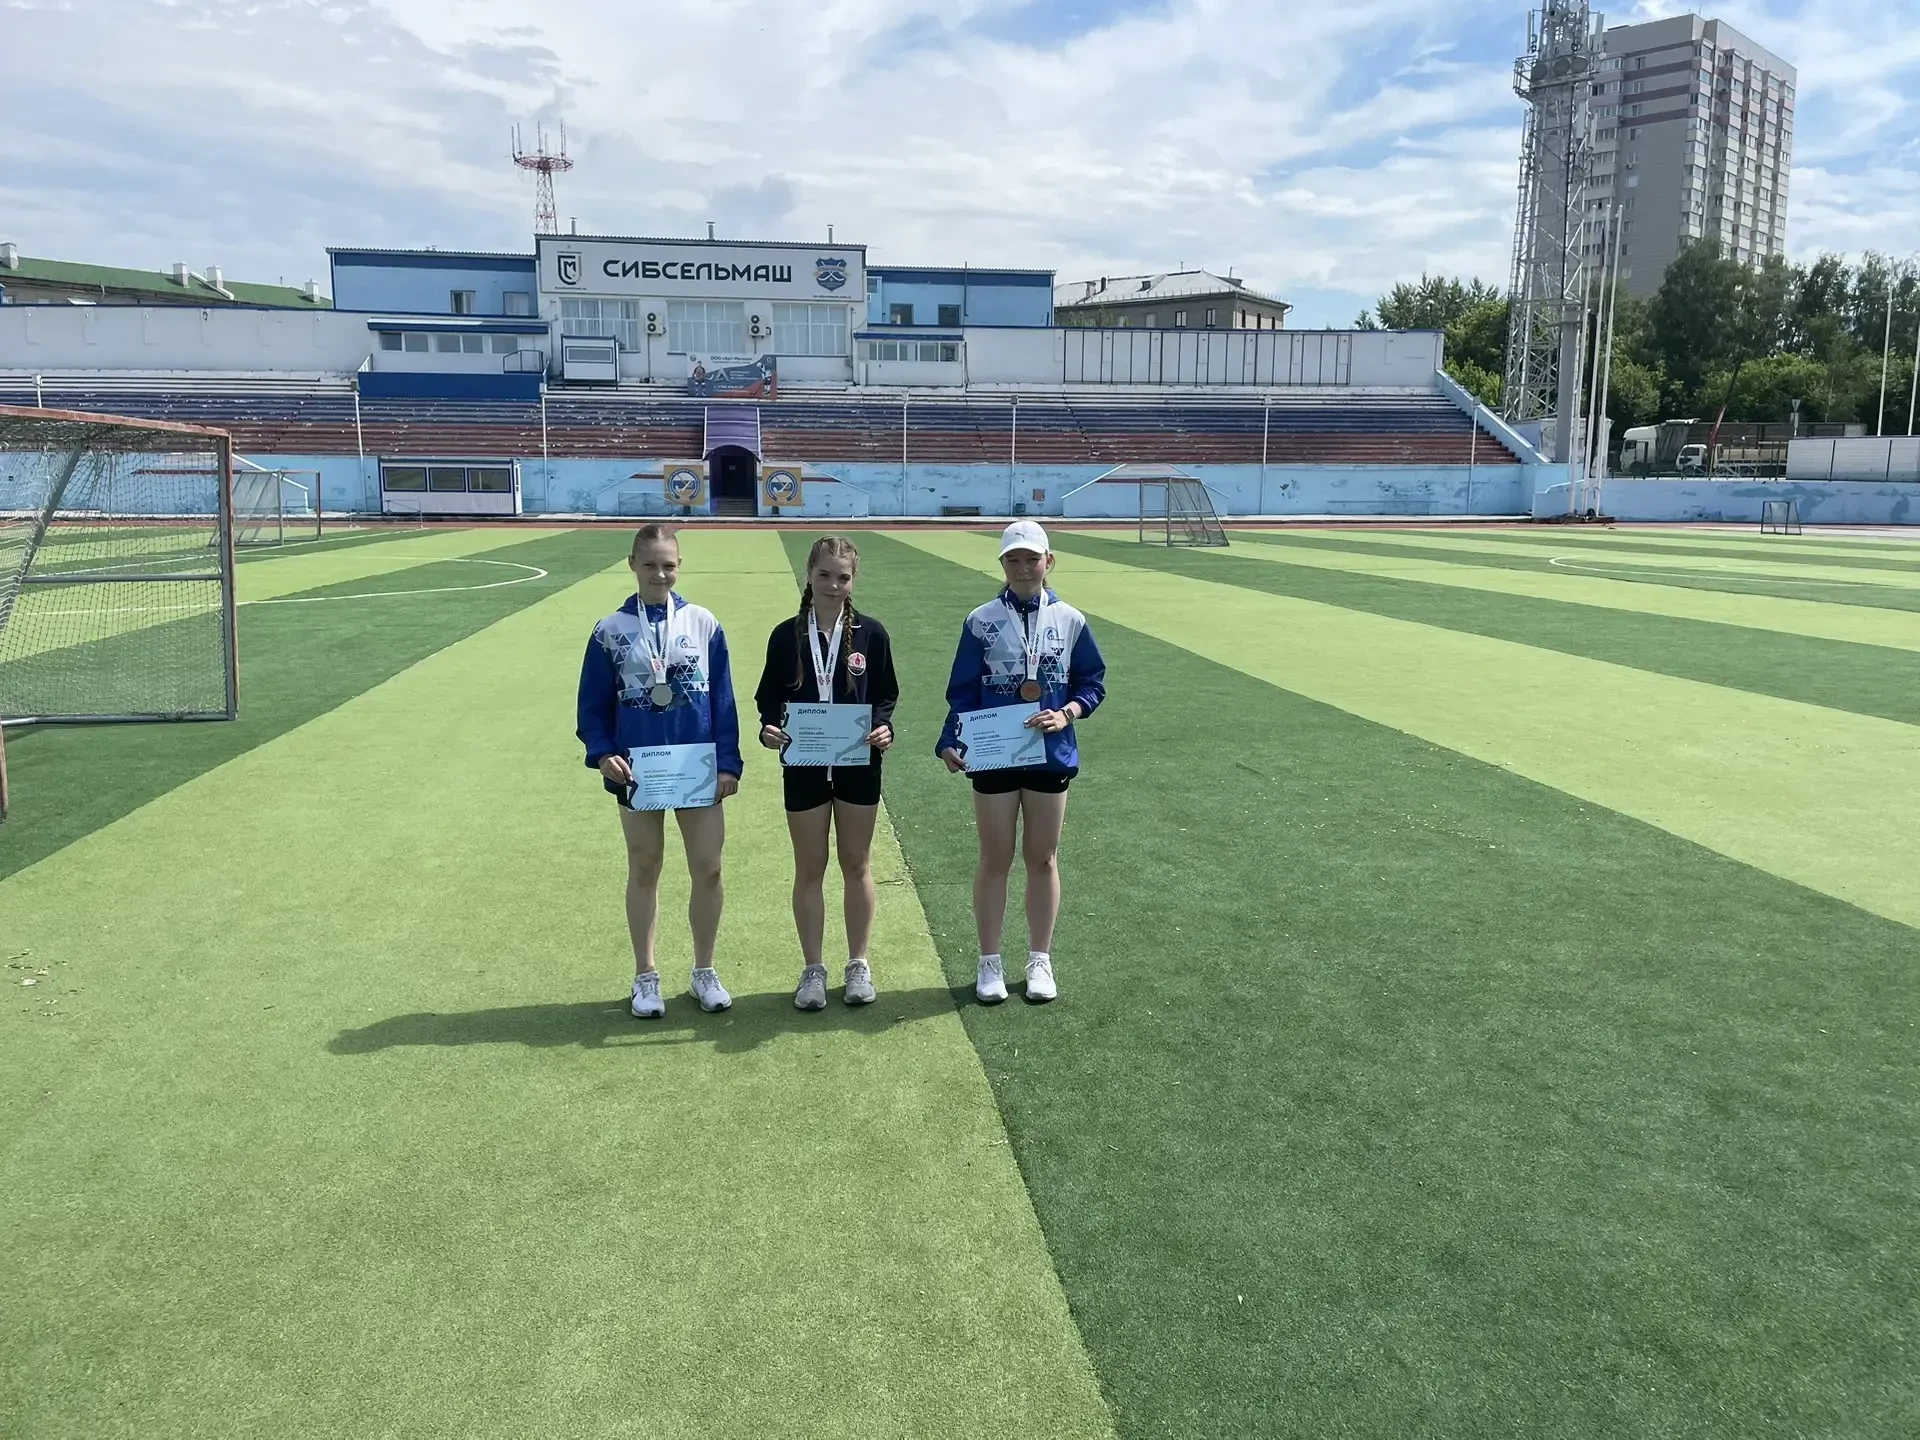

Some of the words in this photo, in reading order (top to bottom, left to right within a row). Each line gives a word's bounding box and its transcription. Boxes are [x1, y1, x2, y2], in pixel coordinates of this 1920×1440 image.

[603, 259, 792, 283] СИБСЕЛЬМАШ
[969, 712, 998, 722] ДИПЛОМ
[641, 750, 672, 758] ДИПЛОМ
